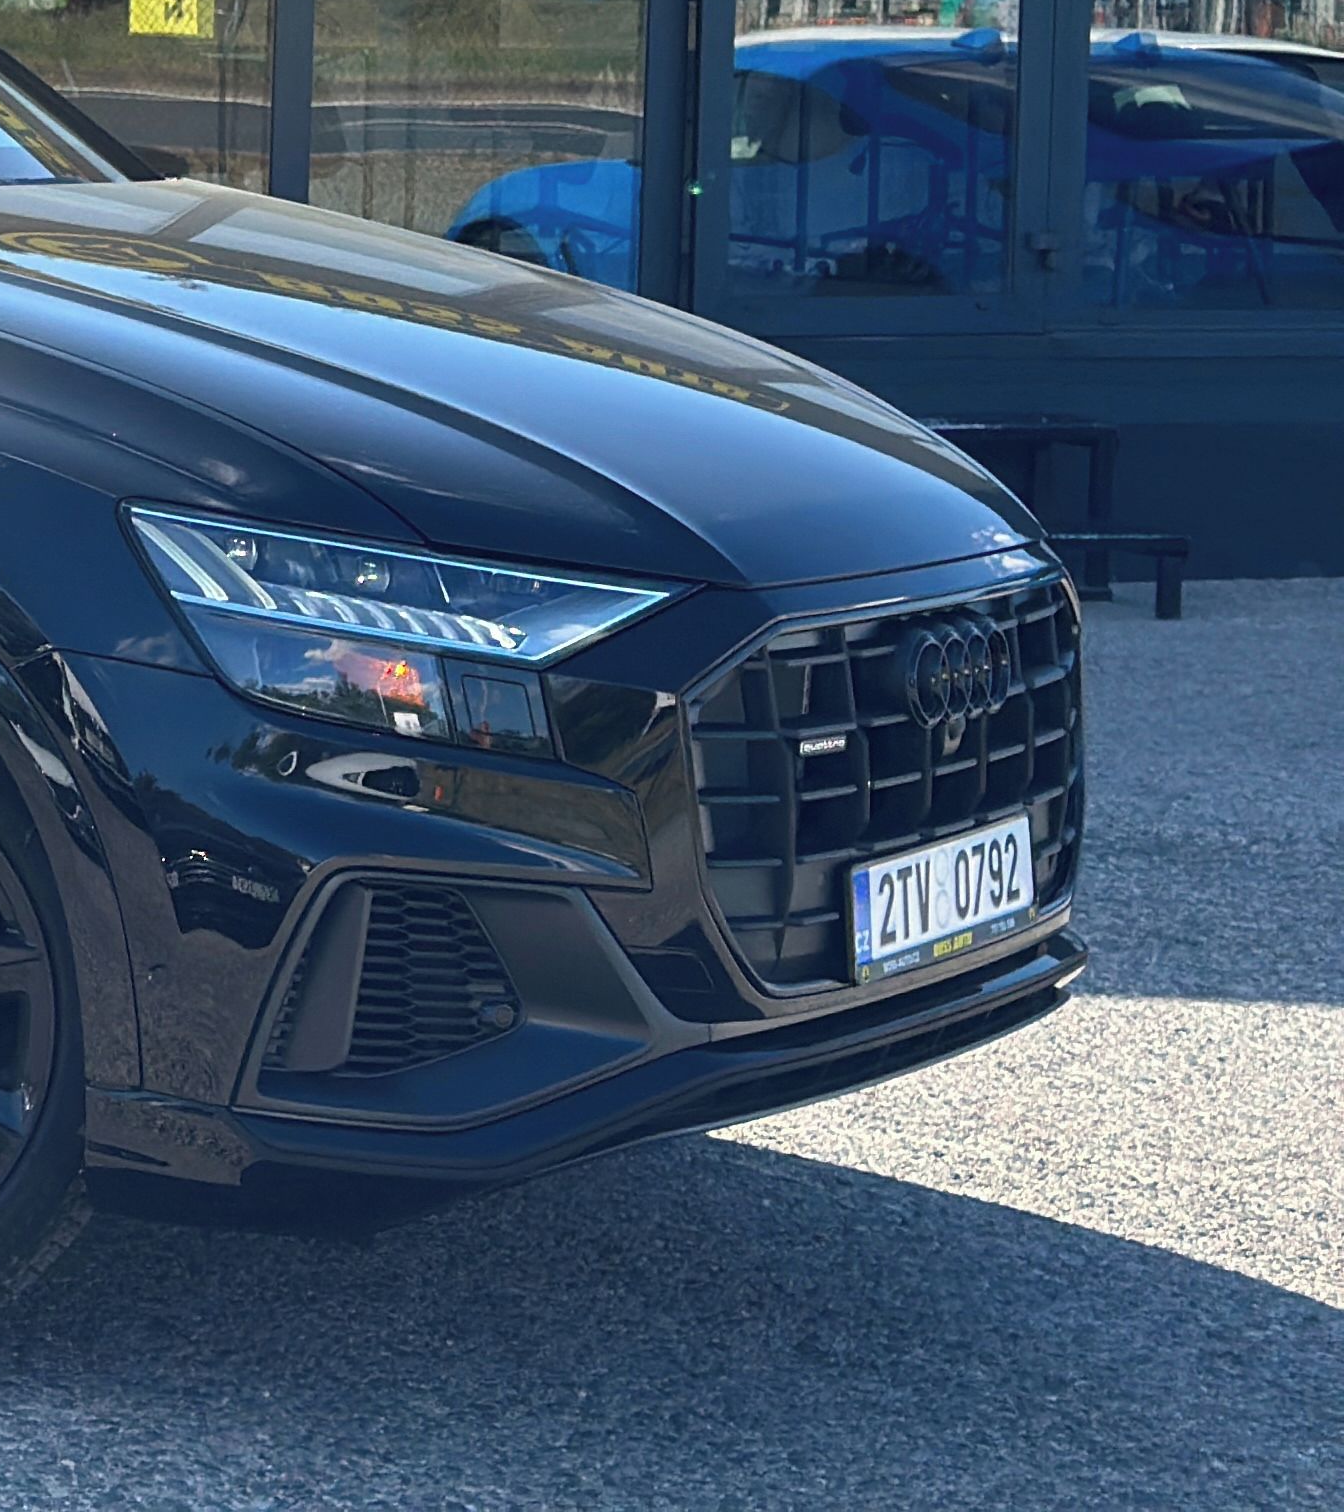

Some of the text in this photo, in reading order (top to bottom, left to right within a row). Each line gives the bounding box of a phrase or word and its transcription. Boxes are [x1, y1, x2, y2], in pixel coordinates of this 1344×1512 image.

[878, 833, 1021, 947] 2TV 0792
[855, 929, 871, 953] CZ
